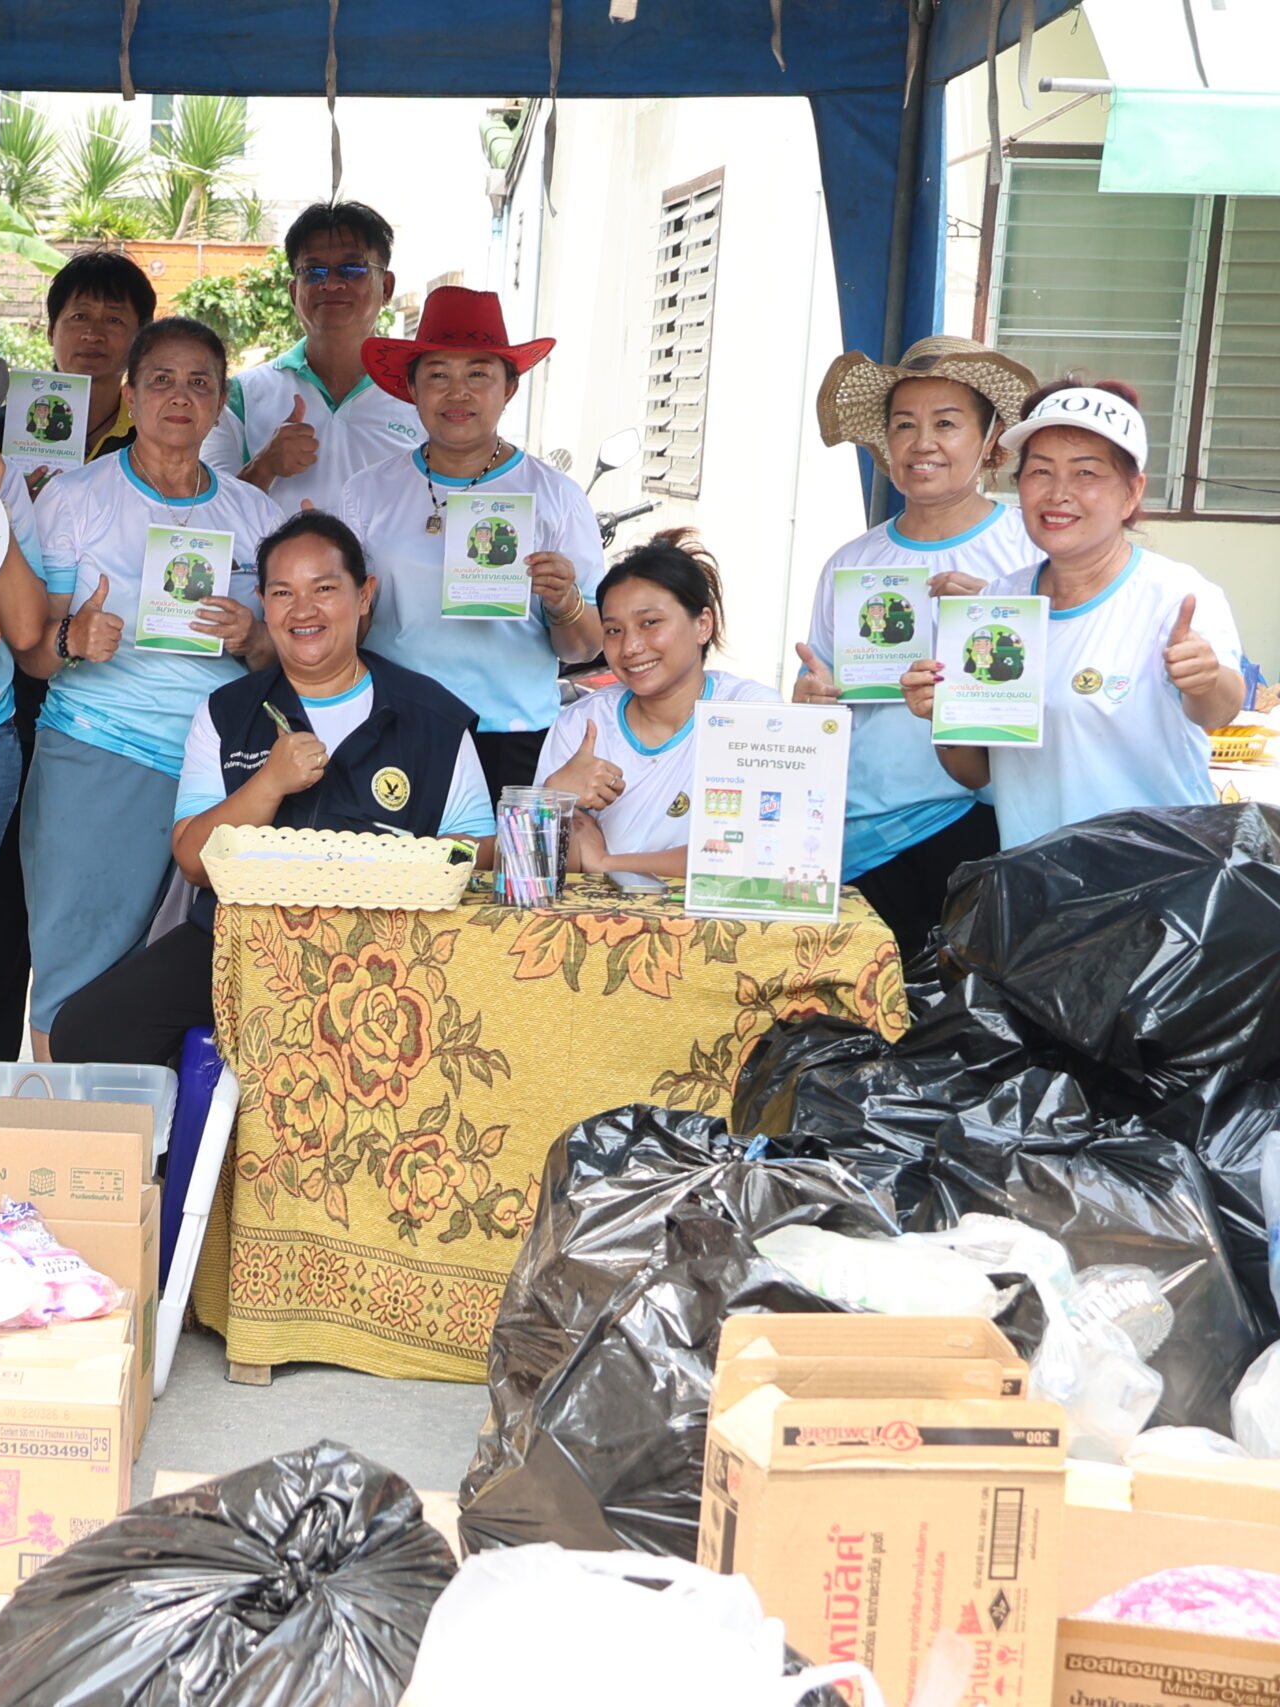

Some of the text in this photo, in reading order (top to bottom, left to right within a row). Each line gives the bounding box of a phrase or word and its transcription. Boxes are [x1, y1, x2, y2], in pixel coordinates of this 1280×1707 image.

[1027, 396, 1137, 437] PORT
[460, 573, 524, 582] ธนาคารขยะชุมชน
[853, 652, 922, 661] ธนาคารขยะชุมชน
[956, 690, 1032, 700] ธนาคารขยะชุมชน
[728, 741, 817, 755] EEP WASTE BANK
[736, 757, 807, 770] ธนาคารขยะ
[1026, 1431, 1051, 1445] 300
[90, 1464, 111, 1474] PINK
[1164, 1680, 1279, 1707] Mabin Oyster
